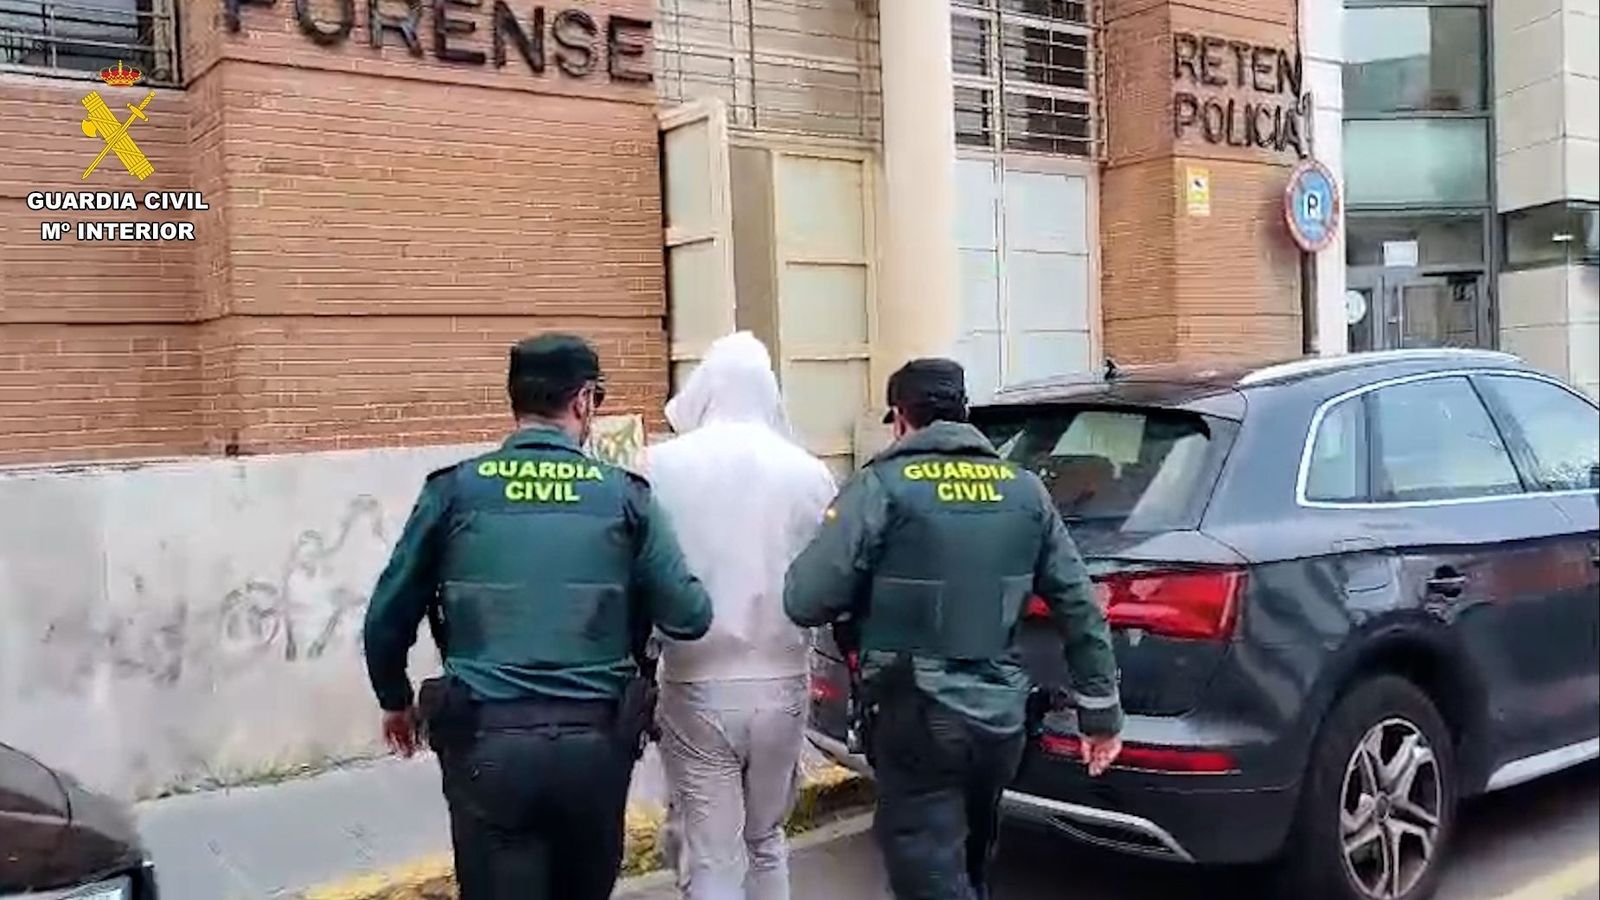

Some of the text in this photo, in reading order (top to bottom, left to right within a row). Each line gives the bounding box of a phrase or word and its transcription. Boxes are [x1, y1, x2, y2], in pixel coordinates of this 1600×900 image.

[478, 460, 603, 480] GUARDIA
[904, 462, 1016, 480] GUARDIA
[505, 480, 580, 502] CIVIL
[938, 482, 1004, 502] CIVIL
